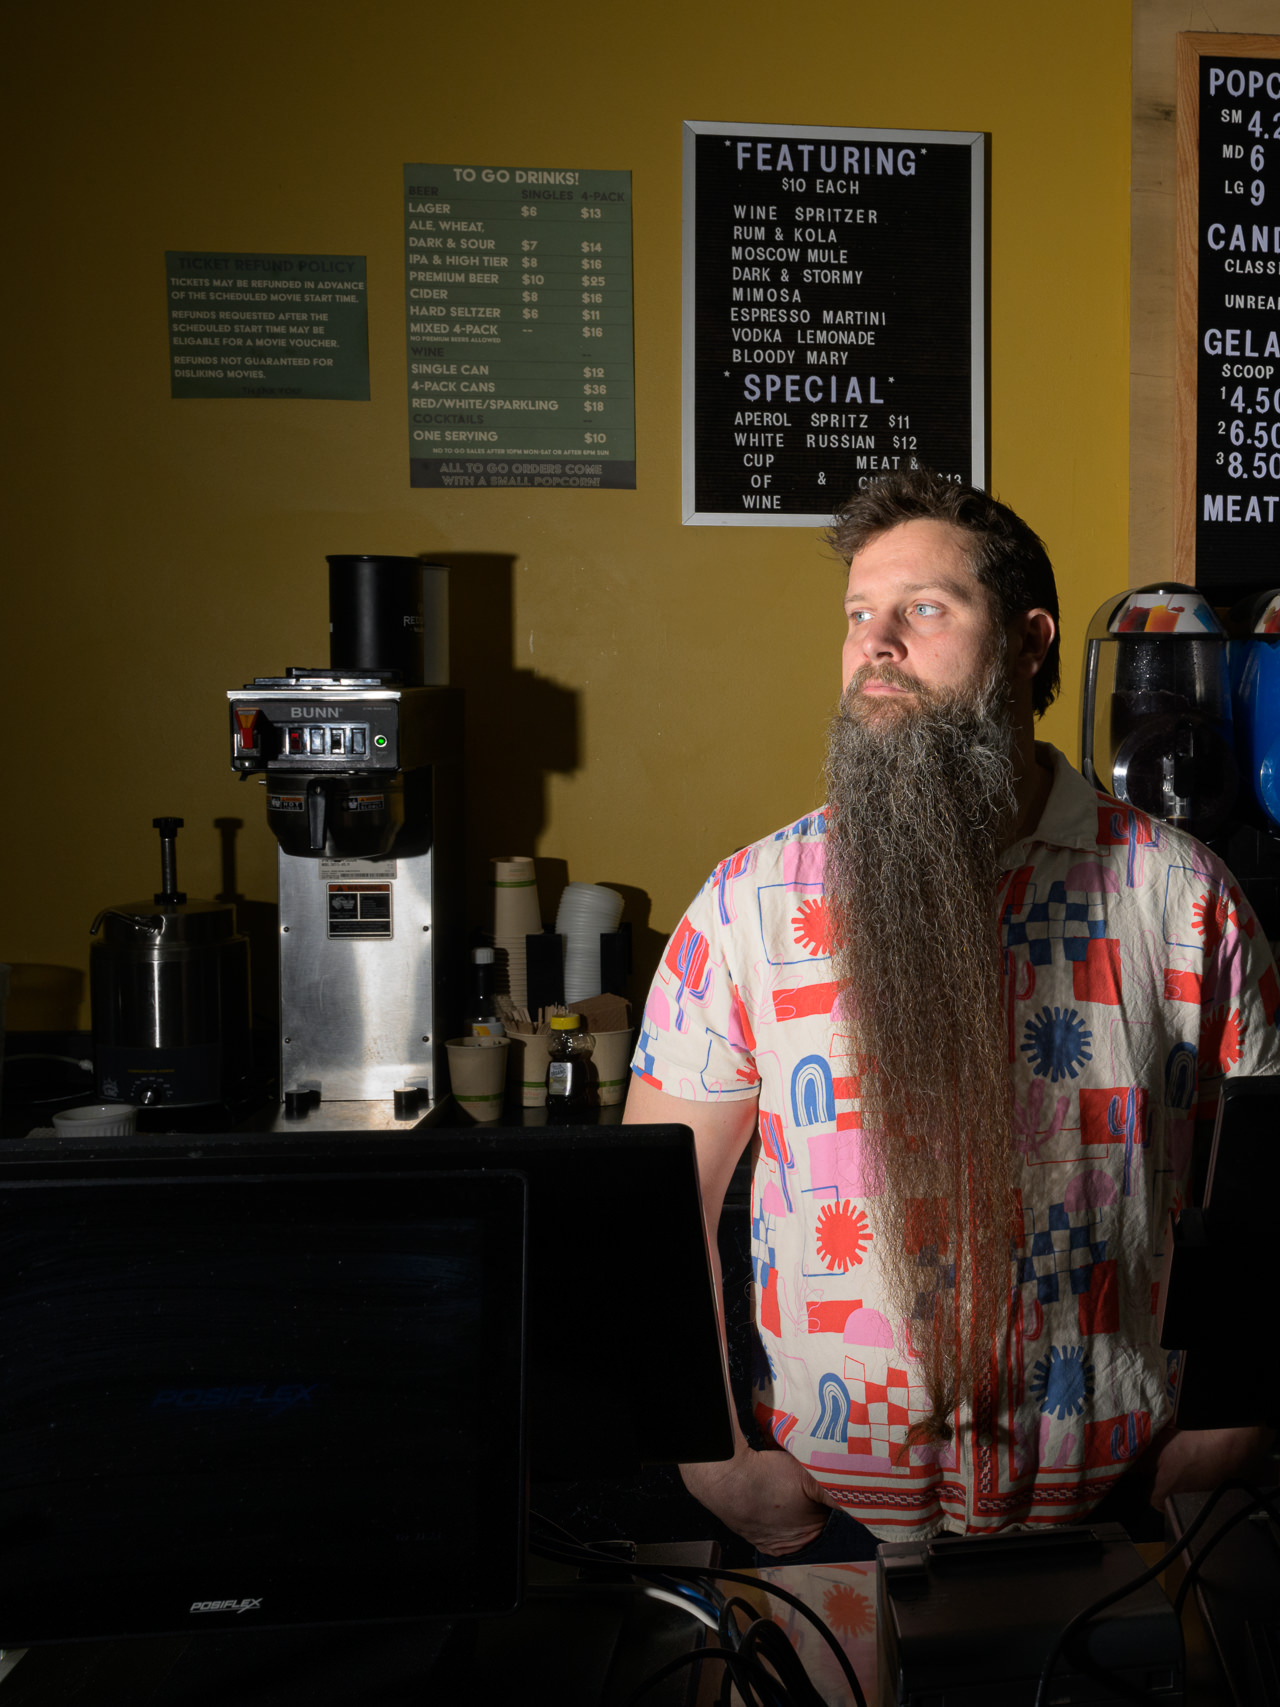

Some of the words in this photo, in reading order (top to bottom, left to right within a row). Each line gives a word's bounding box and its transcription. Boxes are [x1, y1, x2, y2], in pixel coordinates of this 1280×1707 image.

[1221, 109, 1242, 123] SM
[737, 142, 916, 176] FEATURING
[453, 168, 476, 182] TO
[481, 169, 509, 183] GO
[515, 171, 579, 185] DRINKS!
[409, 186, 438, 196] BEER
[782, 178, 806, 193] $10
[816, 179, 859, 194] EACH
[522, 189, 573, 200] SINGLES
[581, 192, 624, 202] 4-PACK
[409, 203, 450, 214] LAGER
[521, 205, 536, 217] $6
[581, 207, 601, 219] $13
[734, 205, 777, 220] WINE
[795, 206, 878, 224] SPRITZER
[732, 246, 800, 262] MOSCOW
[808, 249, 848, 264] MULE
[179, 258, 229, 270] TICKET
[235, 259, 293, 272] REFUND
[300, 260, 355, 273] POLICY
[171, 278, 209, 287] TICKETS
[213, 279, 233, 287] MAY
[251, 280, 300, 288] REFUNDED
[305, 281, 314, 289] IN
[317, 282, 365, 290] ADVANCE
[410, 272, 464, 283] PREMIUM
[469, 273, 499, 284] BEER
[522, 274, 544, 285] $10
[731, 308, 810, 323] ESPRESSO
[823, 310, 886, 326] MARTINI
[410, 323, 449, 333] MIXED
[453, 324, 498, 335] 4-PACK
[174, 356, 217, 364] REFUNDS
[221, 357, 241, 365] NOT
[244, 358, 310, 366] GUARANTEED
[411, 364, 457, 375] SINGLE
[461, 365, 489, 375] CAN
[1222, 363, 1274, 379] SCOOP
[744, 374, 884, 404] SPECIAL
[412, 399, 558, 411] RED/WHITE/SPARKLING
[413, 414, 483, 424] COCKTAILS
[734, 412, 792, 426] APEROL
[811, 412, 868, 428] SPRITZ
[889, 414, 909, 429] $11
[414, 431, 441, 441] ONE
[445, 431, 498, 441] SERVING
[584, 433, 606, 444] $10
[744, 454, 774, 468] CUP
[856, 456, 900, 470] MEAT
[910, 456, 918, 470] &
[751, 475, 772, 488] OF
[818, 472, 826, 485] &
[742, 495, 781, 510] WINE
[291, 707, 339, 718] BUNN
[151, 1384, 320, 1416] POSIFLEX
[188, 1598, 264, 1616] POSIFLEX
